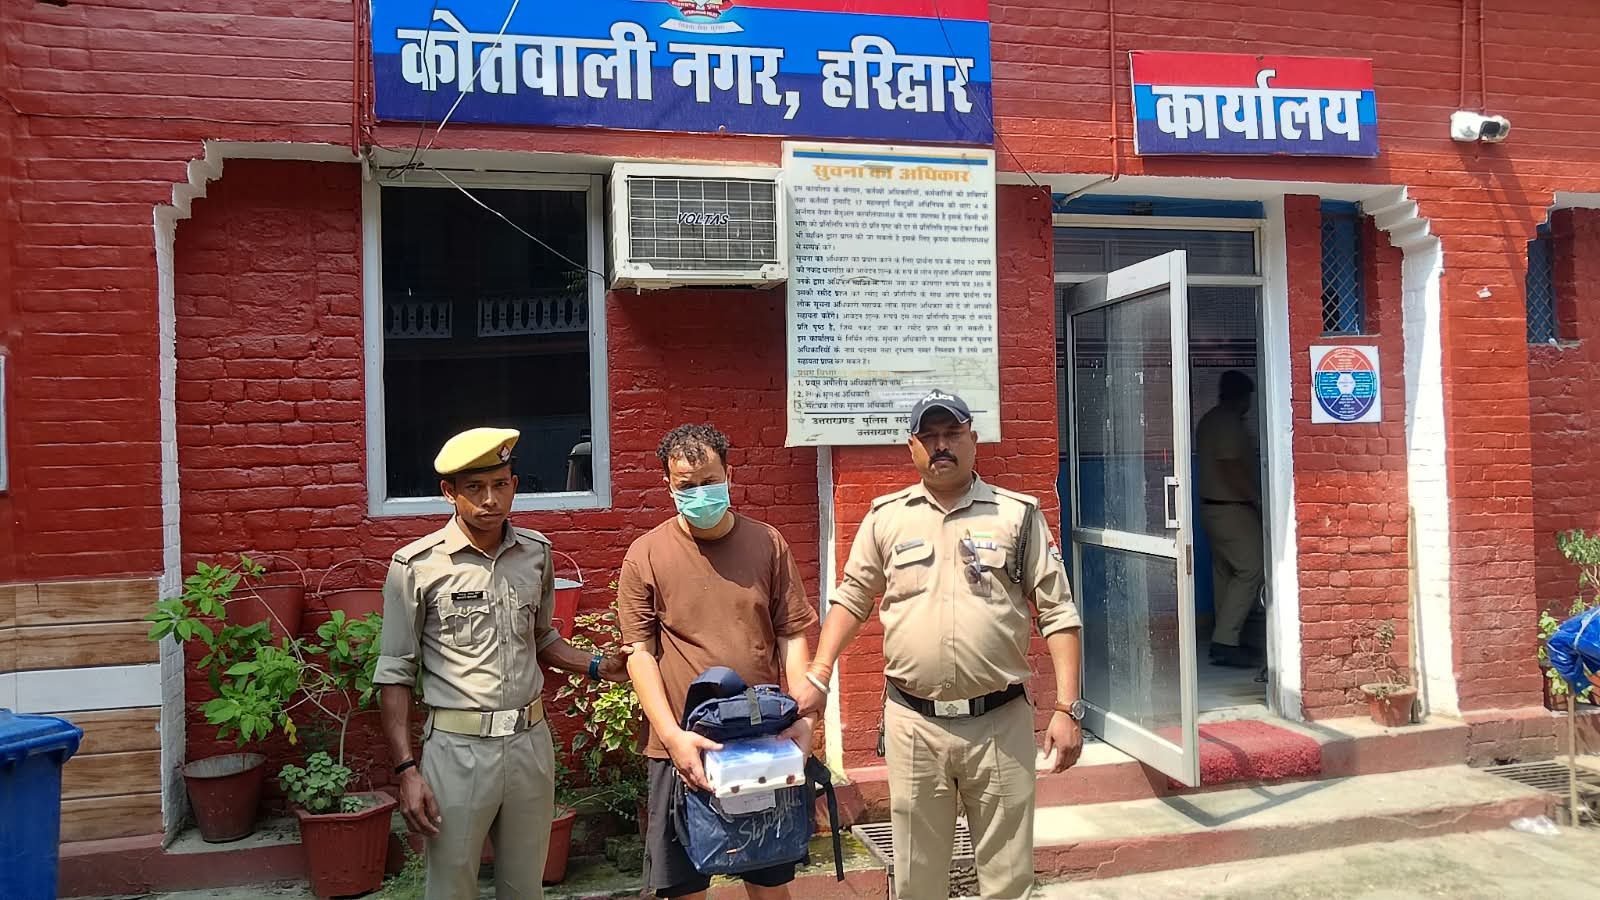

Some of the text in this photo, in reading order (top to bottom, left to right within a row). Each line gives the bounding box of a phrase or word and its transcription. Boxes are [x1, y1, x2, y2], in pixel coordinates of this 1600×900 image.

[397, 9, 974, 120] कोतवाली नगर, हरिद्वार
[1152, 69, 1361, 141] कार्यालय
[812, 164, 864, 181] सूचना
[899, 165, 971, 182] अधिकार
[677, 212, 729, 225] VOLTAS
[812, 417, 855, 425] उत्तराखण्ड
[862, 414, 888, 427] पुलिस
[857, 428, 899, 436] उत्तराखण्ड
